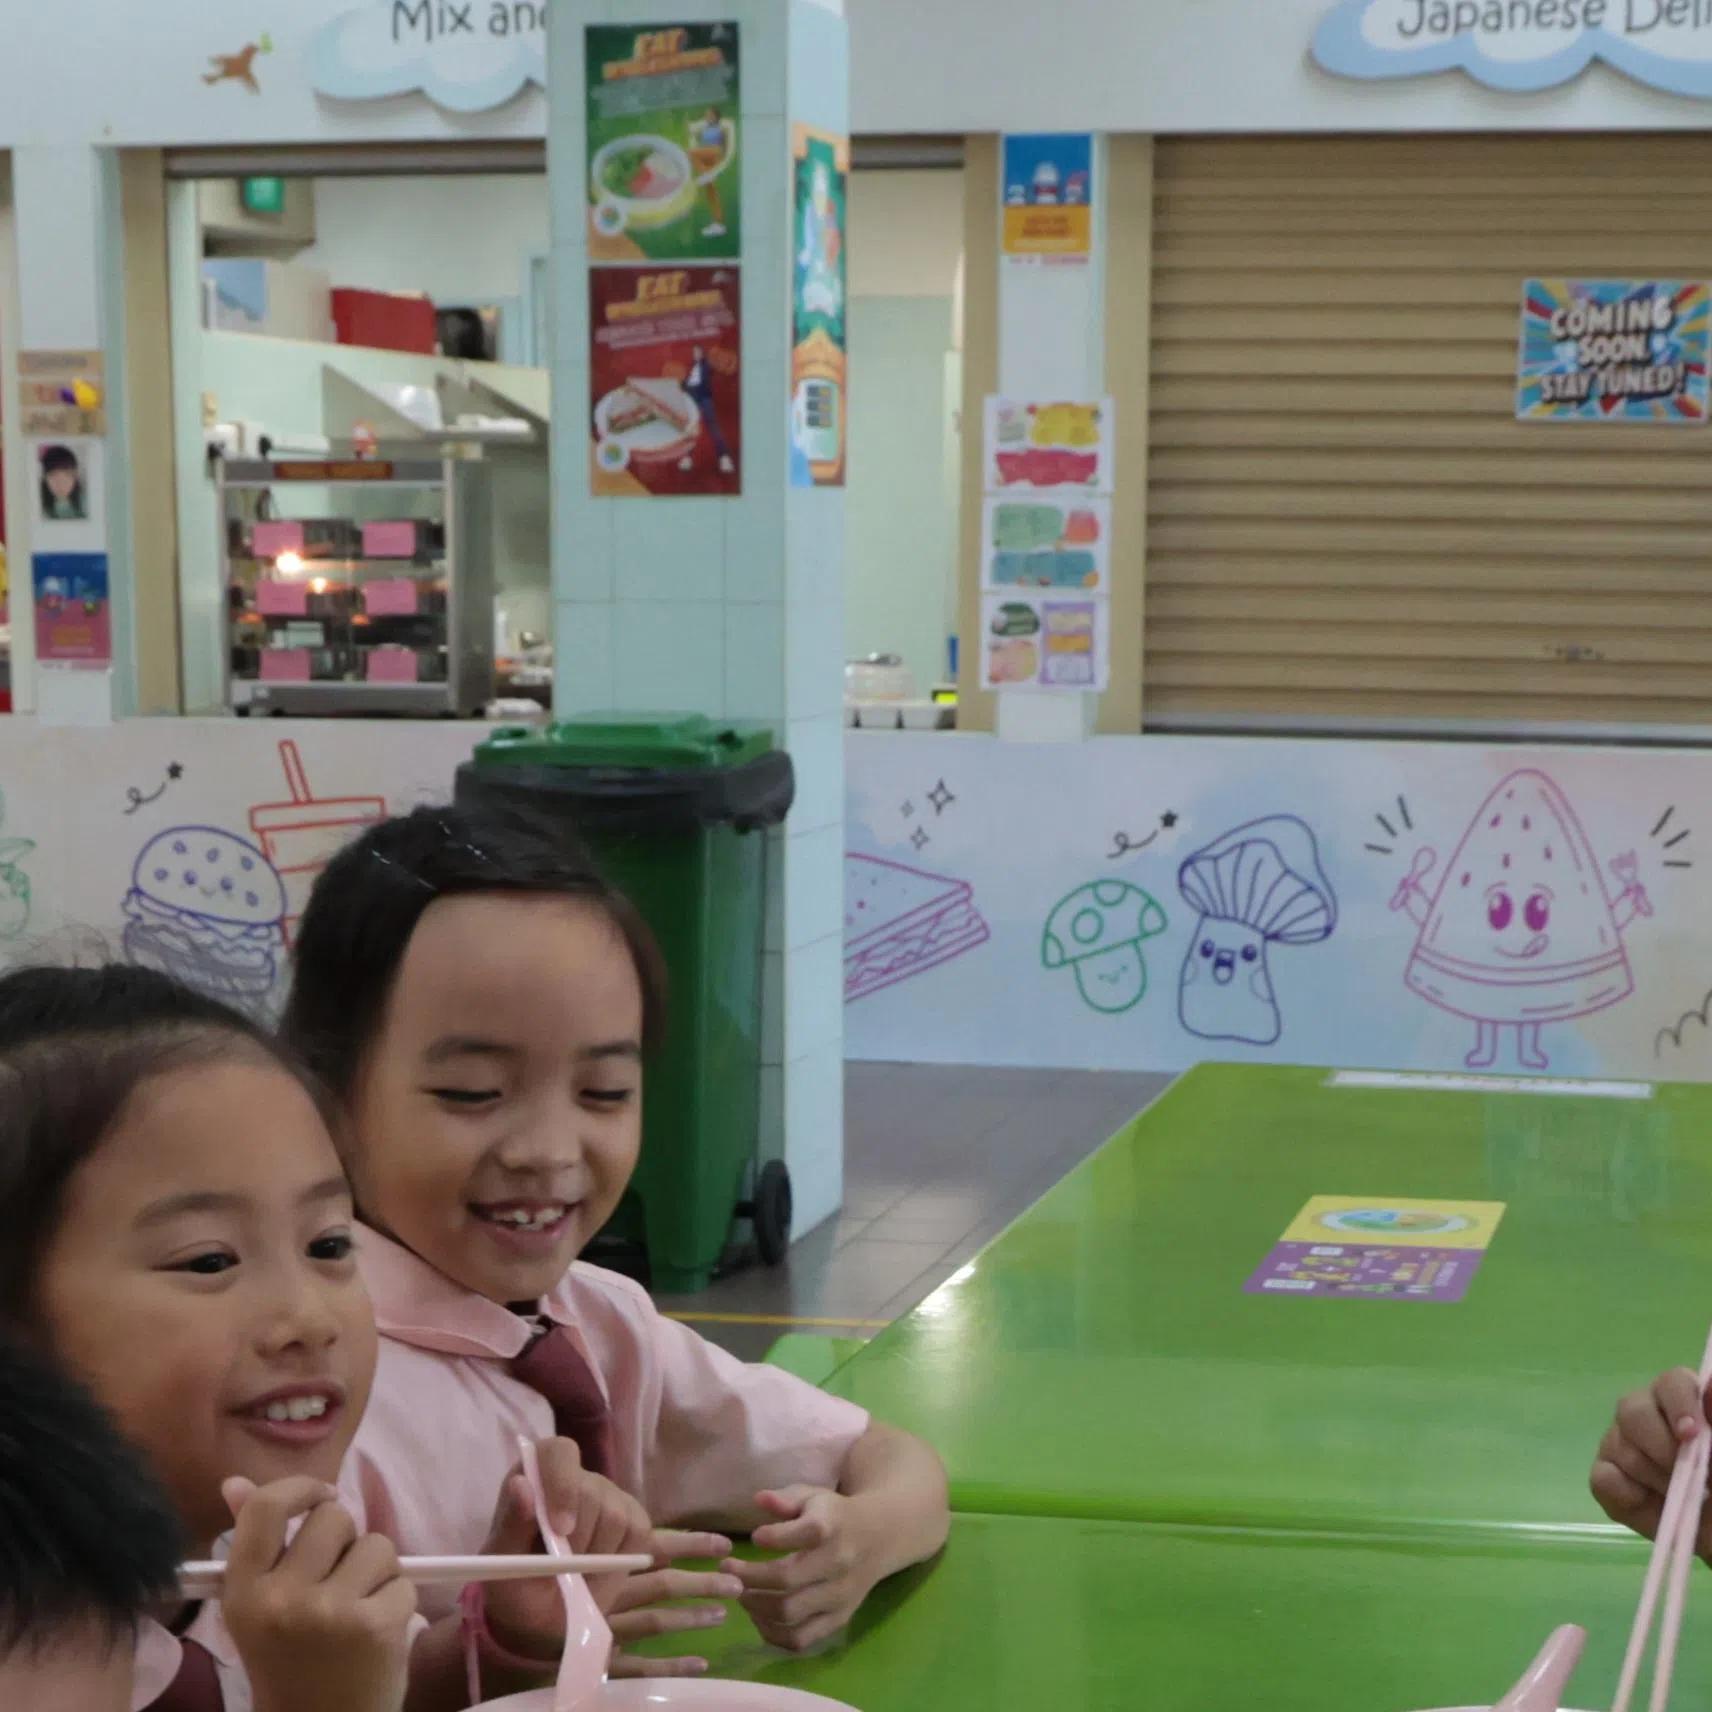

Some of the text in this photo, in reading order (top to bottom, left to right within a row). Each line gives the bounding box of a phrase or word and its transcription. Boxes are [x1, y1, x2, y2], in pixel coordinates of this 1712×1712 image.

[392, 0, 474, 43] Mix
[1396, 0, 1603, 38] Japanese
[1551, 297, 1673, 338] COMING
[1540, 361, 1685, 402] STAY TUNED!
